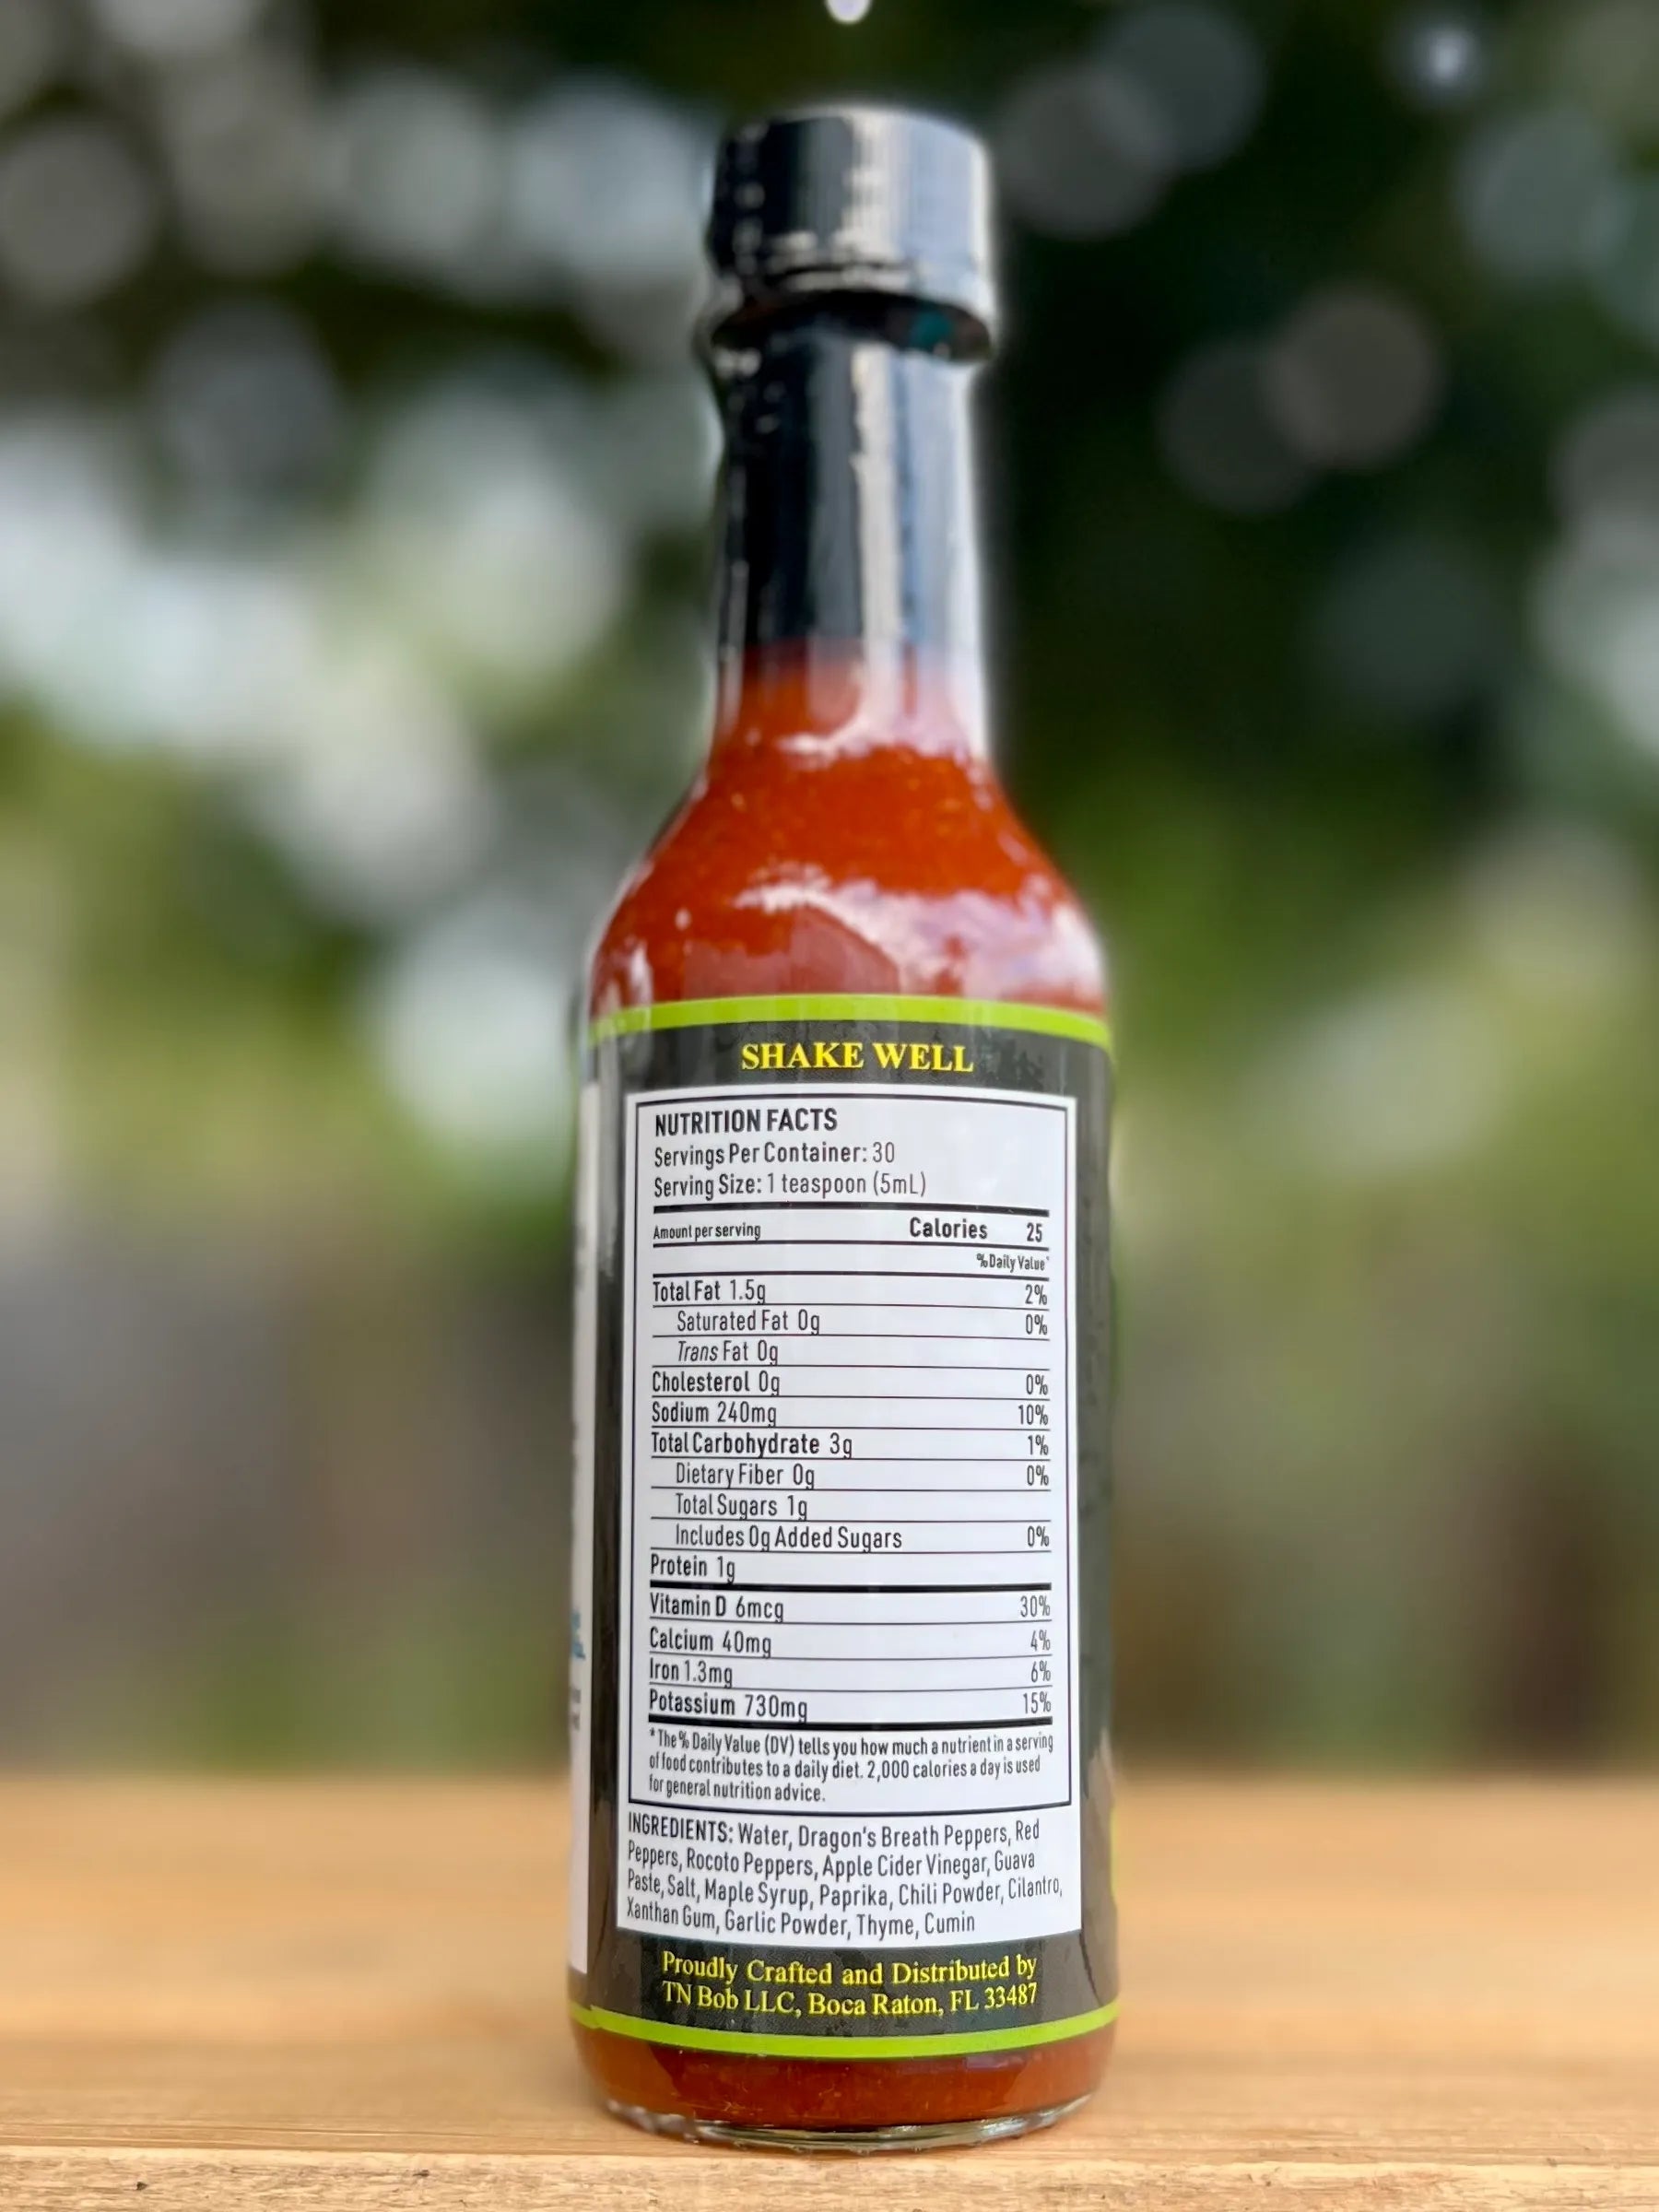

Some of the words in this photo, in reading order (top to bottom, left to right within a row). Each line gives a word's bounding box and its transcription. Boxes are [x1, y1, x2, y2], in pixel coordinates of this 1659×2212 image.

[741, 1041, 865, 1071] SHAKE
[873, 1042, 974, 1073] WELL
[655, 1109, 759, 1137] NUTRITION
[768, 1107, 838, 1133] FACTS
[654, 1144, 724, 1171] Servings
[729, 1143, 759, 1165] Per
[764, 1142, 867, 1164] Container:
[873, 1141, 895, 1163] 30
[654, 1176, 714, 1201] Serving
[719, 1175, 762, 1196] Size:
[768, 1174, 775, 1194] 1
[782, 1174, 865, 1200] teaspoon
[873, 1171, 926, 1198] (5mL)
[653, 1221, 692, 1240] Amount
[695, 1224, 712, 1241] per
[714, 1221, 760, 1241] serving
[910, 1217, 988, 1240] Calories
[1027, 1222, 1042, 1242] 25
[653, 1281, 691, 1301] Total
[695, 1280, 720, 1300] Fat
[730, 1279, 766, 1304] 1.5g
[1025, 1284, 1047, 1305] 2%
[677, 1310, 756, 1332] Saturated
[760, 1309, 789, 1331] Fat
[798, 1309, 819, 1335] 0g
[1025, 1313, 1047, 1335] 0%
[677, 1341, 718, 1362] Trans
[723, 1340, 748, 1361] Fat
[758, 1341, 778, 1365] 0g
[652, 1371, 749, 1394] Cholesterol
[759, 1371, 780, 1396] 0g
[1025, 1373, 1048, 1395] 0%
[652, 1401, 709, 1424] Sodium
[717, 1402, 776, 1427] 240mg
[1018, 1404, 1048, 1425] 10%
[652, 1431, 690, 1453] Total
[693, 1432, 819, 1458] Carbohydrate
[830, 1433, 853, 1459] 3g
[1028, 1434, 1048, 1455] 1%
[676, 1464, 734, 1488] Dietary
[739, 1464, 783, 1485] Fiber
[793, 1465, 814, 1489] 0g
[1026, 1465, 1049, 1486] 0%
[676, 1493, 712, 1515] Total
[717, 1495, 777, 1520] Sugars
[787, 1495, 807, 1520] 1g
[676, 1524, 744, 1547] Includes
[748, 1525, 771, 1550] 0g
[774, 1525, 832, 1548] Added
[838, 1526, 902, 1552] Sugars
[1027, 1526, 1049, 1547] 0%
[650, 1553, 708, 1577] Protein
[717, 1556, 735, 1583] 1g
[650, 1593, 711, 1617] Vitamin
[716, 1595, 726, 1618] D
[735, 1596, 784, 1623] 6mcg
[1020, 1596, 1050, 1618] 30%
[649, 1628, 713, 1653] Calcium
[723, 1630, 771, 1658] 40mg
[1030, 1630, 1051, 1651] 4%
[649, 1658, 679, 1682] Iron
[684, 1660, 733, 1688] 1.3mg
[1030, 1661, 1051, 1683] 6%
[649, 1688, 735, 1717] Potassium
[745, 1693, 807, 1722] 730mg
[1023, 1691, 1051, 1714] 15%
[658, 1728, 677, 1748] The
[679, 1729, 689, 1748] %
[692, 1730, 722, 1755] Daily
[724, 1732, 760, 1753] Value
[765, 1733, 794, 1757] (DV)
[799, 1735, 830, 1755] tells
[833, 1739, 856, 1759] you
[861, 1735, 888, 1756] how
[892, 1735, 928, 1755] much
[931, 1740, 938, 1755] a
[943, 1734, 992, 1754] nutrient
[994, 1734, 1005, 1751] in
[1007, 1738, 1014, 1750] a
[1016, 1731, 1053, 1753] serving
[649, 1751, 660, 1770] of
[662, 1752, 686, 1773] food
[689, 1754, 763, 1777] contributes
[767, 1759, 779, 1777] to
[782, 1761, 790, 1777] a
[794, 1758, 829, 1781] daily
[832, 1758, 863, 1778] diet.
[867, 1758, 909, 1781] 2,000
[913, 1757, 966, 1778] calories
[970, 1759, 977, 1776] a
[981, 1755, 1001, 1779] day
[1004, 1756, 1014, 1774] is
[1016, 1755, 1041, 1772] used
[649, 1773, 664, 1794] for
[666, 1776, 711, 1800] general
[713, 1779, 771, 1801] nutrition
[774, 1781, 825, 1803] advice.
[628, 1811, 734, 1843] INGREDIENTS:
[739, 1822, 794, 1849] Water,
[798, 1825, 876, 1853] Dragon's
[882, 1824, 939, 1848] Breath
[944, 1820, 1011, 1850] Peppers,
[1016, 1818, 1040, 1841] Red
[628, 1840, 682, 1871] Peppers,
[687, 1849, 739, 1872] Rocoto
[744, 1852, 818, 1879] Peppers,
[823, 1853, 874, 1877] Apple
[877, 1852, 922, 1877] Cider
[926, 1851, 990, 1877] Vinegar,
[994, 1848, 1035, 1871] Guava
[628, 1868, 664, 1898] Paste,
[668, 1874, 700, 1901] Salt,
[705, 1878, 753, 1905] Maple
[758, 1882, 814, 1910] Syrup,
[819, 1883, 894, 1910] Paprika,
[900, 1882, 937, 1906] Chili
[943, 1879, 1005, 1905] Powder,
[1008, 1874, 1063, 1901] Cilantro,
[627, 1896, 679, 1926] Xanthan
[683, 1906, 720, 1933] Gum,
[724, 1909, 775, 1933] Garlic
[780, 1911, 851, 1940] Powder,
[857, 1912, 920, 1940] Thyme,
[924, 1910, 975, 1934] Cumin
[662, 1950, 737, 1983] Proudly
[747, 1959, 832, 1985] Crafted
[842, 1962, 883, 1984] and
[891, 1956, 1009, 1984] Distributed
[1017, 1953, 1037, 1980] by
[662, 1981, 691, 2006] TN
[698, 1985, 738, 2010] Bob
[745, 1991, 801, 2018] LLC,
[808, 1994, 865, 2016] Boca
[872, 1991, 944, 2018] Raton,
[950, 1990, 979, 2012] FL
[984, 1983, 1037, 2009] 33487
